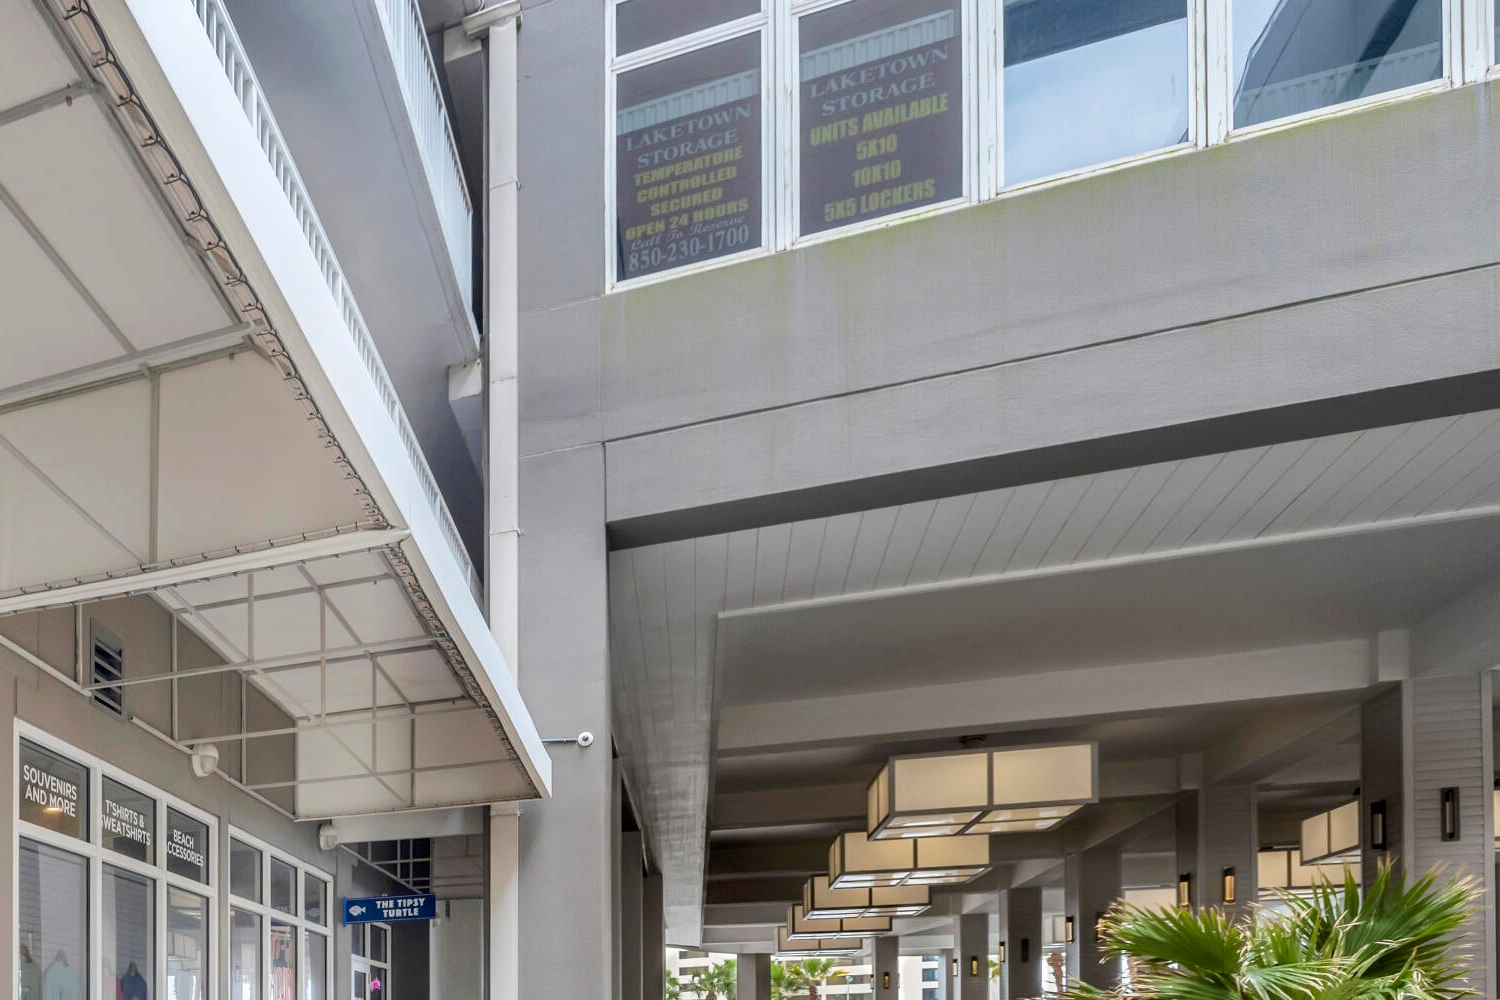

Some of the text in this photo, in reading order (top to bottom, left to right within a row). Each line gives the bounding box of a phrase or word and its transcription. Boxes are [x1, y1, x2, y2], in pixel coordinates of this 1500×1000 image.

[810, 45, 949, 98] LAKETOWN
[821, 72, 936, 116] STORAGE
[627, 104, 751, 150] LAKETOWN
[810, 92, 949, 147] UNITS AVAILABLE
[637, 129, 739, 168] STORAGE
[856, 133, 899, 161] 5X10
[634, 146, 743, 186] TEMPERATURE
[852, 160, 901, 188] 10X10
[637, 166, 737, 203] CONTROLLED
[651, 188, 723, 217] SECURED
[824, 178, 936, 222] 5X5 LOCKERS
[625, 199, 749, 241] OPEN 24 HOURS
[631, 216, 746, 250] Call To Reserve
[629, 225, 749, 272] 850-230-1700
[23, 765, 77, 801] SOUVENIRS
[25, 784, 76, 818] AND MORE
[105, 799, 145, 828] T'SHIRTS &
[167, 841, 205, 867] CCESSORIES
[173, 829, 194, 850] BEACH
[376, 897, 425, 909] THE TIPSY
[383, 908, 419, 918] TURTLE
